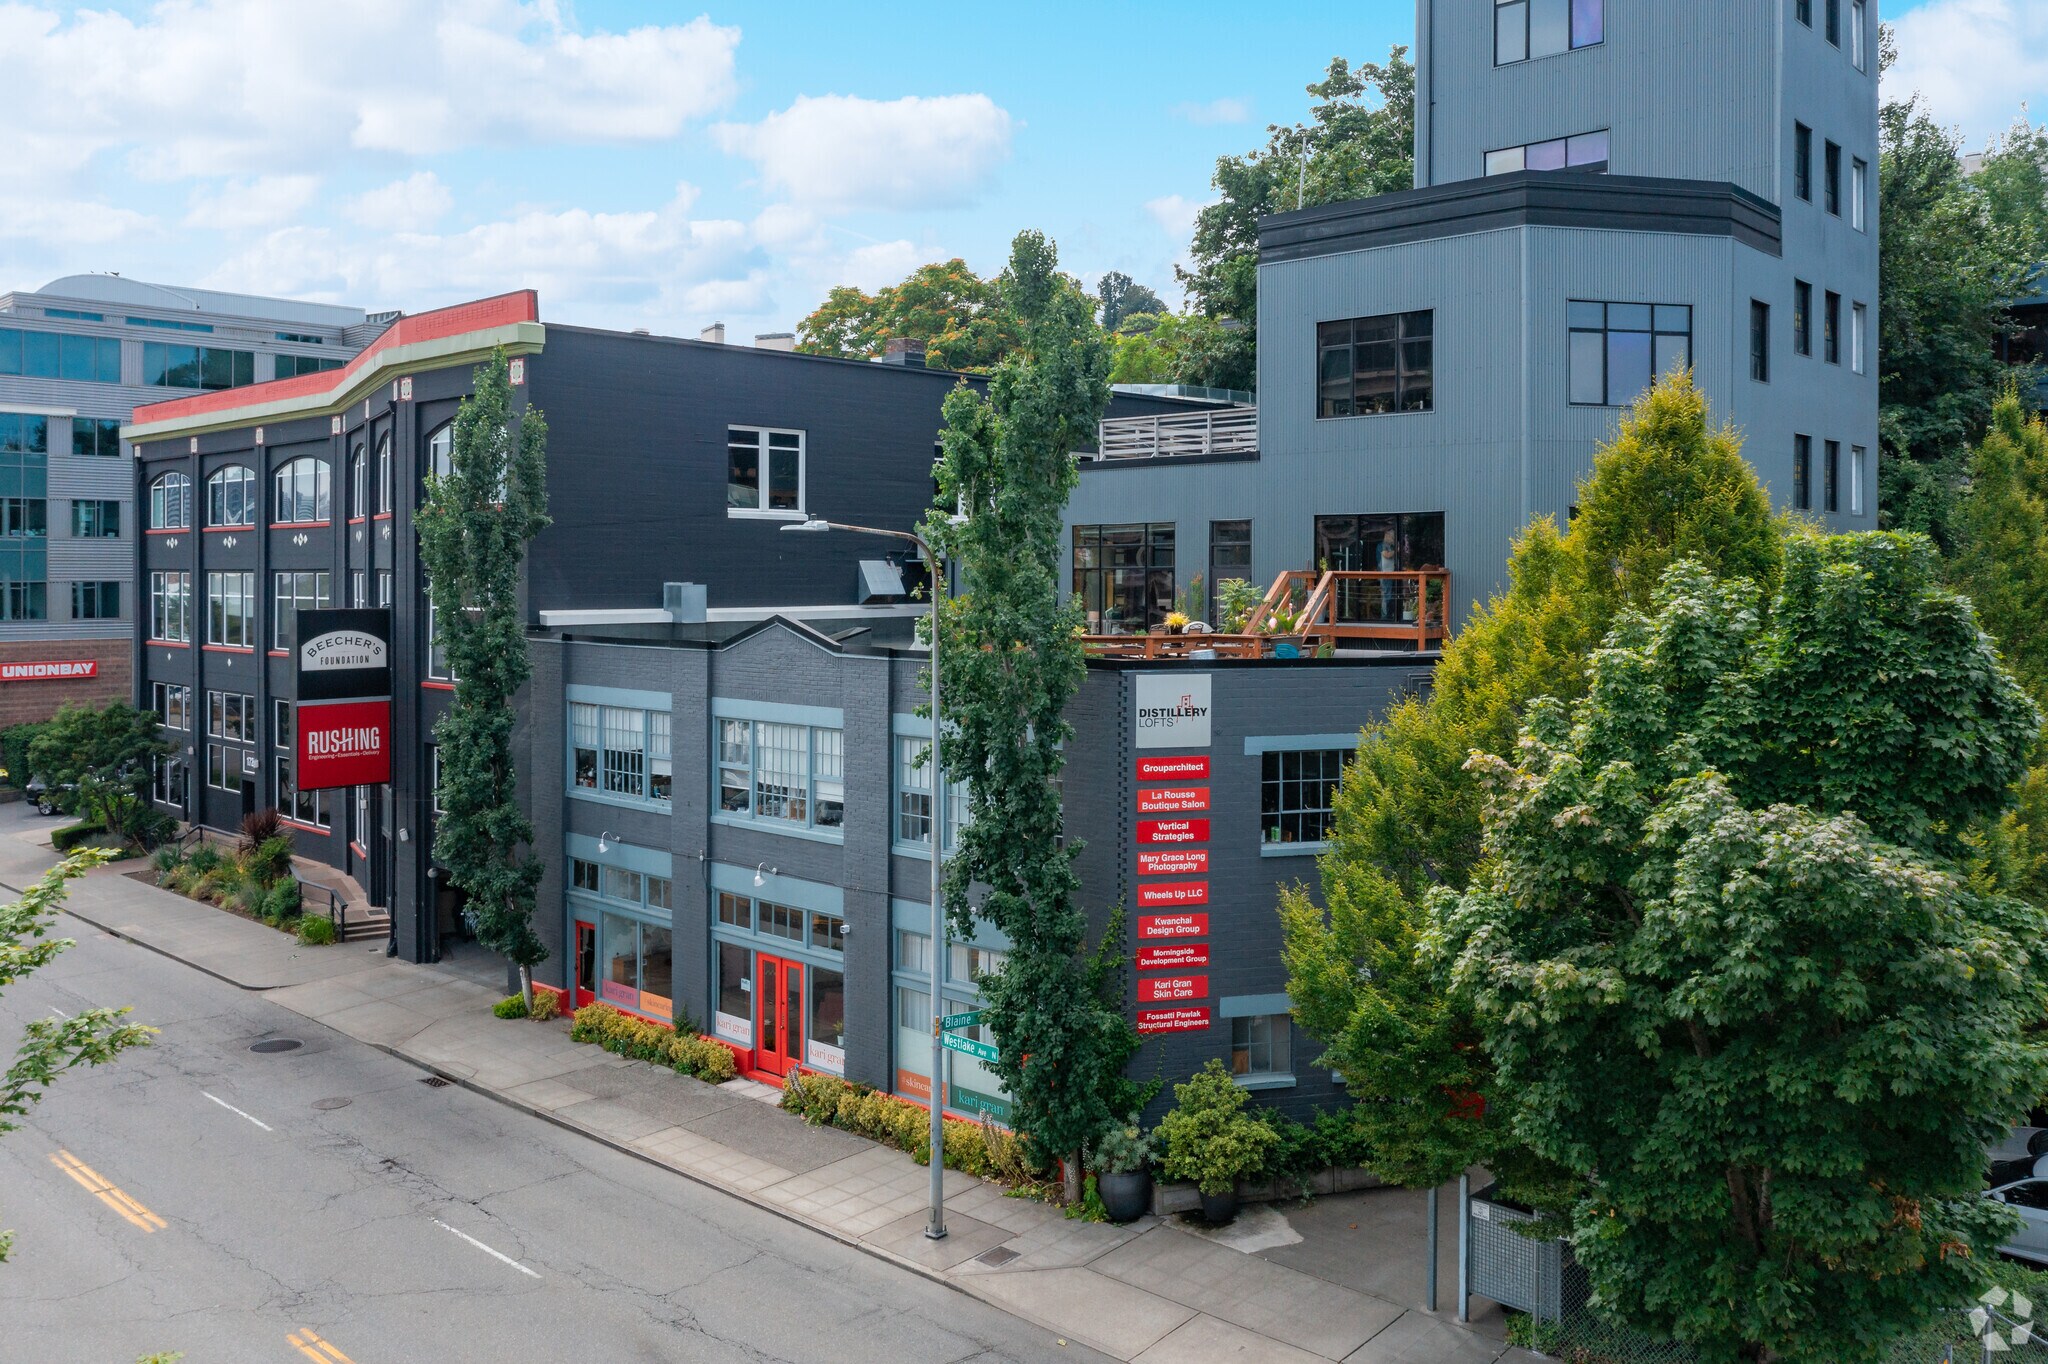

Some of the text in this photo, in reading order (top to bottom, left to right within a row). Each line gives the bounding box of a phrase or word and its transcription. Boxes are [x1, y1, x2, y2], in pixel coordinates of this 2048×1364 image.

[307, 636, 382, 658] BEECHER'S
[321, 655, 369, 665] FOUNDATION
[2, 663, 93, 677] UNIONBAY
[1139, 707, 1207, 718] DISTILLERY
[1139, 718, 1174, 727] LOFTS
[308, 727, 380, 754] RUSHING
[1143, 763, 1203, 773] Grouparchitect
[1152, 791, 1195, 799] La Rousse
[1142, 800, 1205, 810] Boutique Salon
[1158, 822, 1189, 830] Vertical
[1152, 832, 1194, 841] Strategies
[1140, 852, 1205, 864] Mary Grace Long
[1148, 862, 1197, 871] Photography
[1144, 889, 1202, 899] Wheels Up LLC
[1155, 917, 1192, 925] Kwanchai
[1147, 925, 1200, 935] Design Group
[1153, 948, 1194, 958] Morningside
[1141, 956, 1207, 966] Development Group
[1154, 979, 1192, 989] Kari Gran
[1154, 988, 1193, 998] Skin Care
[1147, 1010, 1201, 1021] Fossatti Pawlak
[717, 1016, 749, 1036] kari gran
[946, 1016, 971, 1027] Blaine
[1138, 1018, 1209, 1030] Structural Engineers
[944, 1034, 975, 1053] Westlake
[978, 1048, 986, 1057] Ave
[810, 1045, 825, 1059] kari
[959, 1090, 1003, 1115] kari gran
